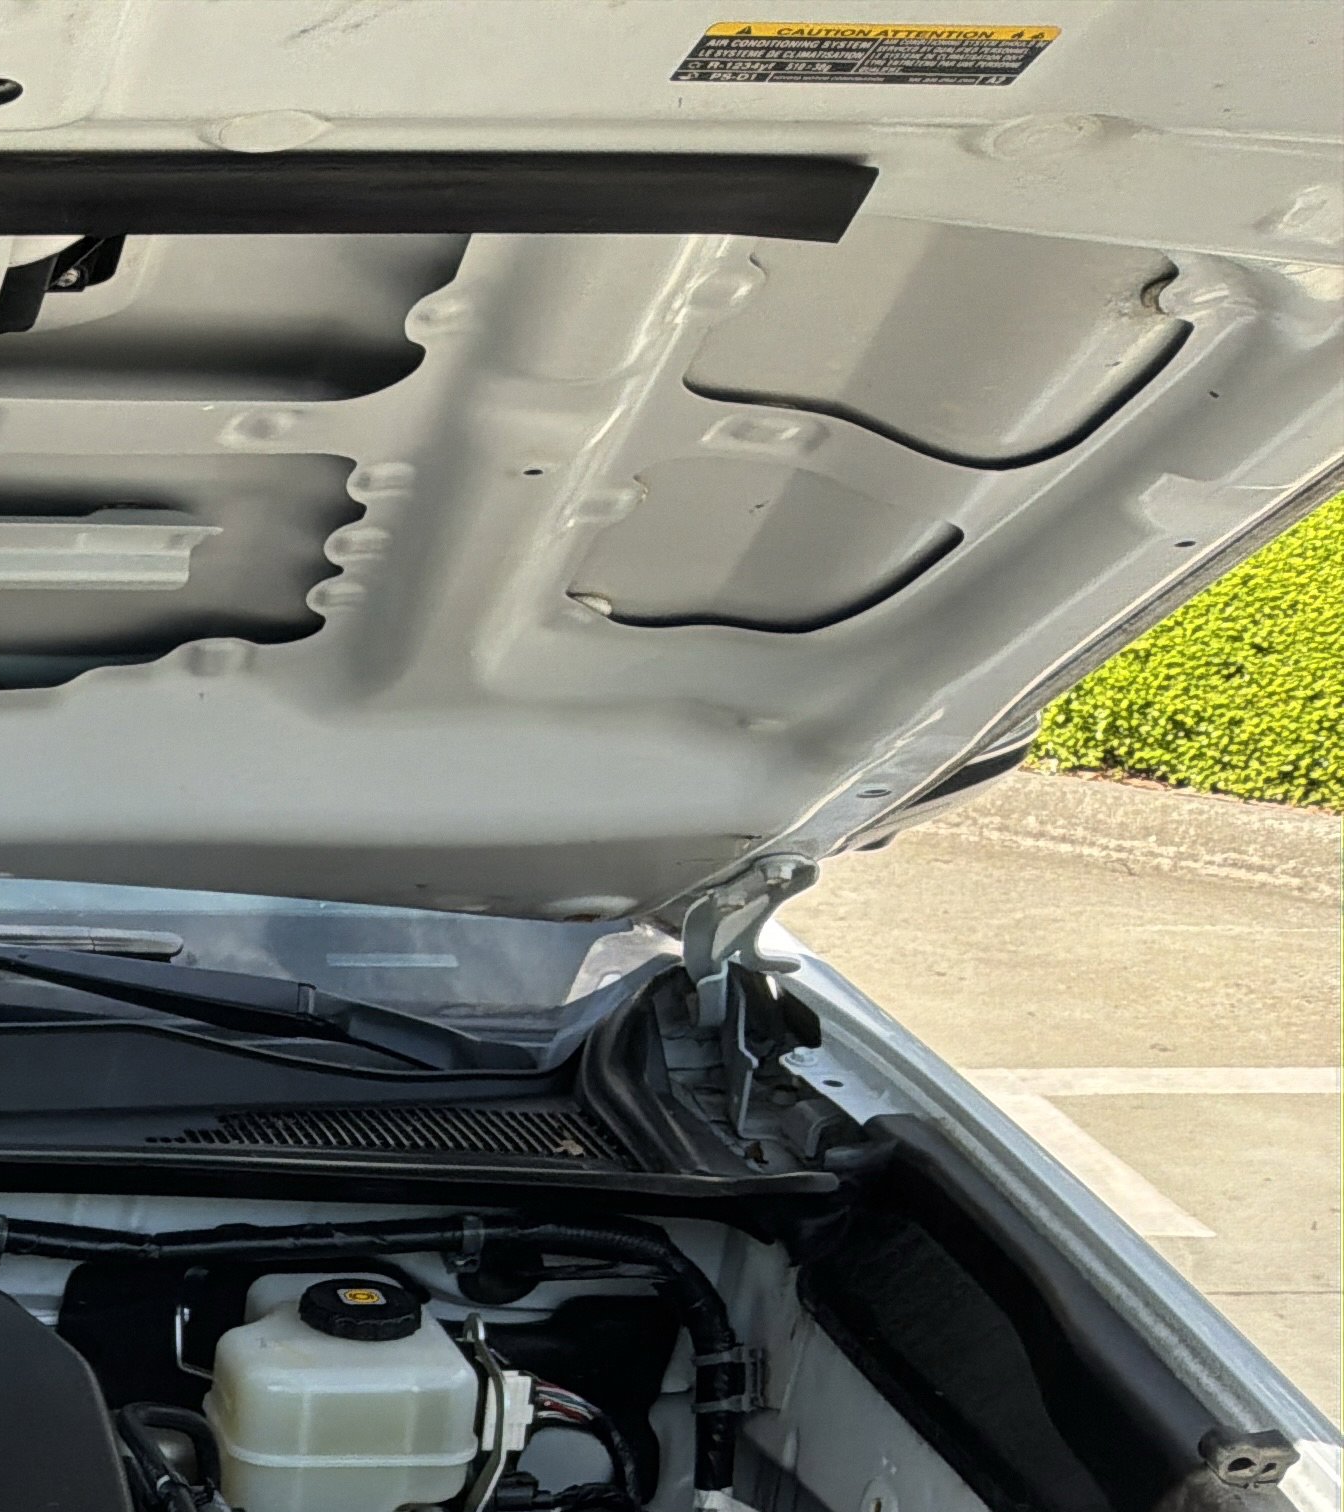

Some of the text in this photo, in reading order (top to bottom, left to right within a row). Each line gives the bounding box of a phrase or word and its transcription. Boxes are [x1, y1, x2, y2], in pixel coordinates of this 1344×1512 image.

[776, 27, 870, 37] CAUTION
[874, 29, 995, 39] ATTENTION
[706, 38, 873, 49] AIR CONDITIONING SYSTEM
[781, 51, 863, 60] CLIMATISATION
[707, 61, 775, 72] R-1234yf
